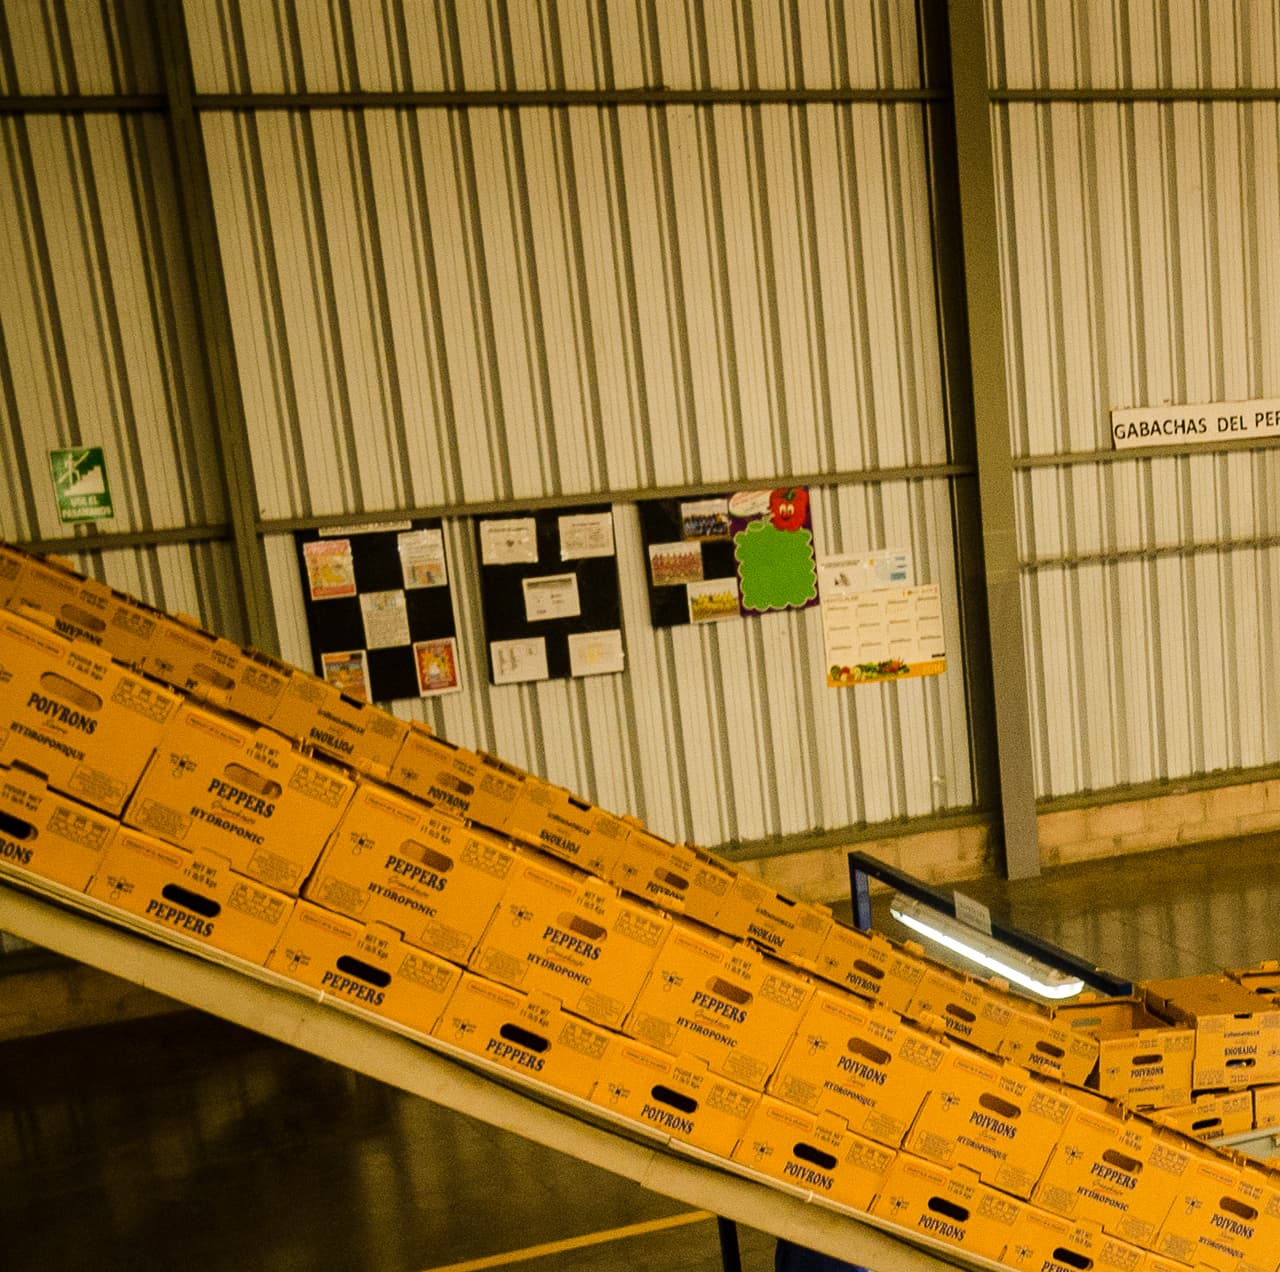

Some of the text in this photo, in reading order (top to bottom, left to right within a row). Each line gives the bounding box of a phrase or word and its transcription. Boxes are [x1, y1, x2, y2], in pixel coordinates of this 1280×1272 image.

[1114, 418, 1207, 440] GABACHAS
[1217, 414, 1248, 433] DEL
[27, 693, 97, 735] POIVRONS
[10, 722, 85, 761] HYDROPONIQUE
[208, 779, 276, 819] PEPPERS
[190, 807, 265, 845] HYDROPONIC
[384, 854, 448, 892] PEPPERS
[368, 882, 437, 918] HYDROPONIC
[145, 899, 214, 937] PEPPERS
[542, 926, 601, 961] PEPPERS
[528, 953, 591, 985] HYDROPONIC
[321, 971, 385, 1006] PEPPERS
[692, 991, 747, 1023] PEPPERS
[676, 1016, 737, 1048] HYDROPONIC
[486, 1038, 545, 1072] PEPPERS
[837, 1056, 887, 1086] POIVRONS
[641, 1104, 694, 1134] POIVRONS
[969, 1111, 1017, 1140] POIVRONS
[784, 1161, 834, 1190] POIVRONS
[1090, 1162, 1138, 1190] PEPPERS
[1077, 1186, 1129, 1212] HYDROPONIC
[918, 1214, 966, 1241] POIVRONS
[1211, 1214, 1254, 1239] POIVRONS
